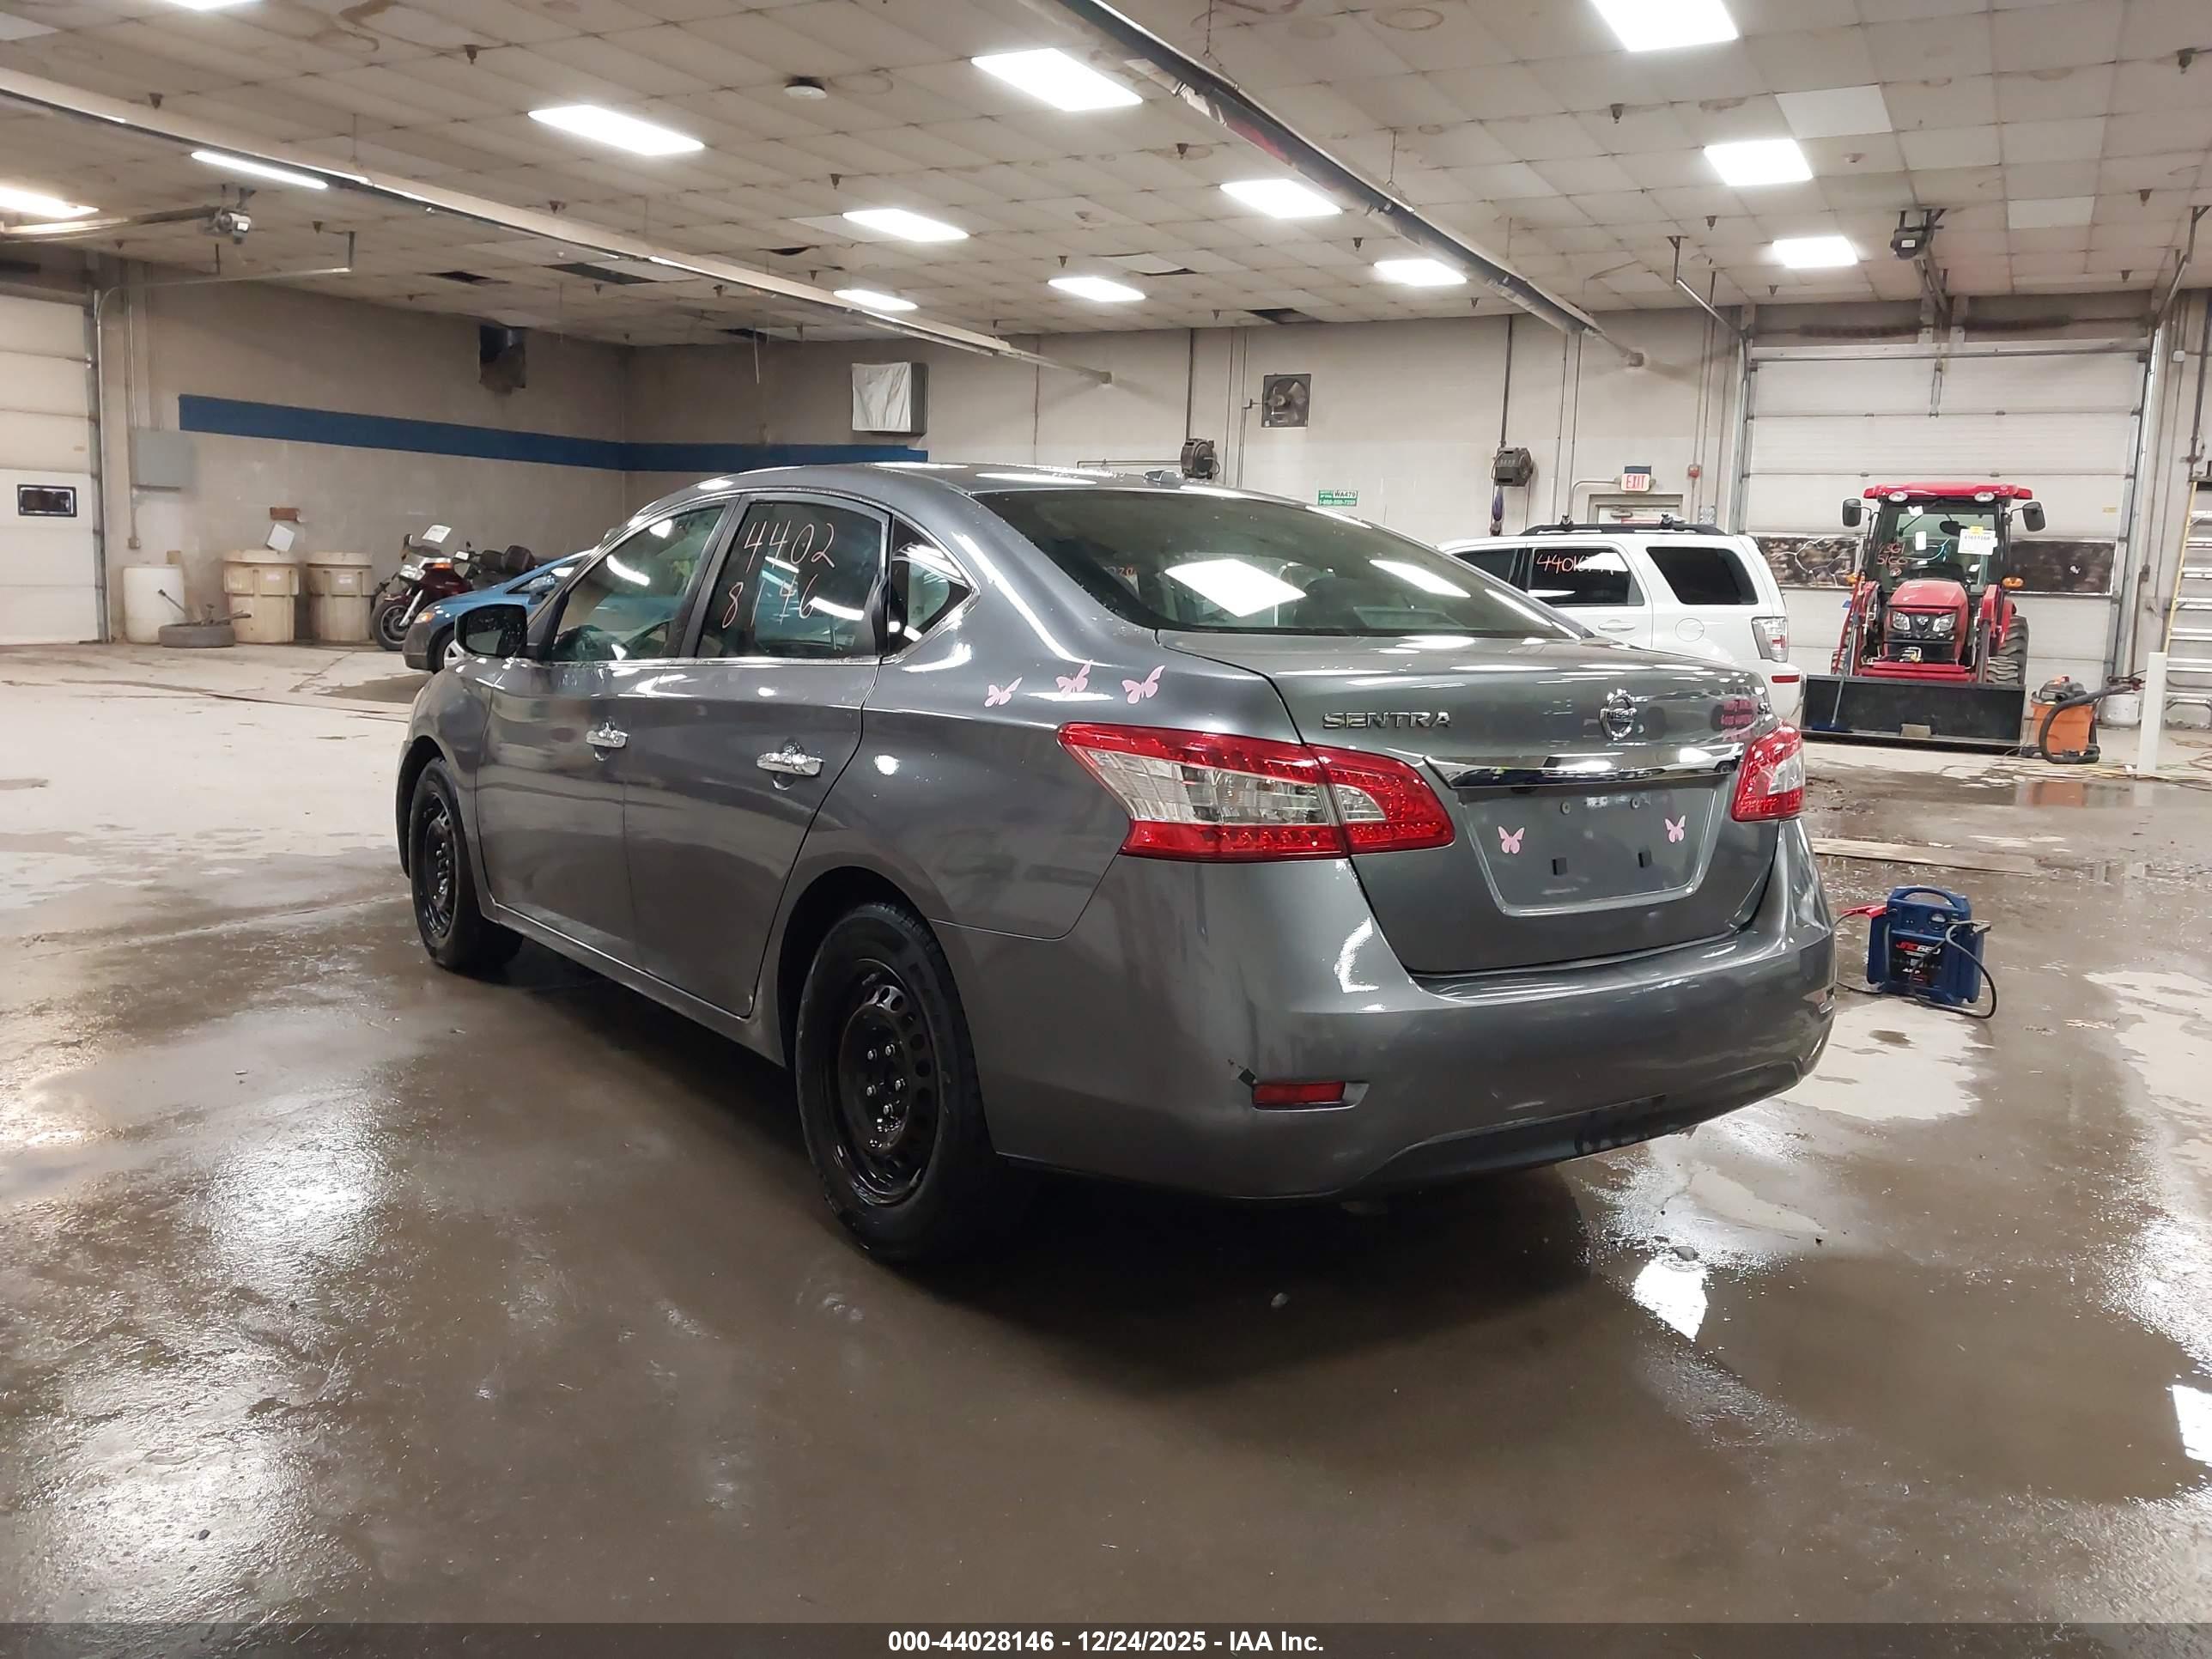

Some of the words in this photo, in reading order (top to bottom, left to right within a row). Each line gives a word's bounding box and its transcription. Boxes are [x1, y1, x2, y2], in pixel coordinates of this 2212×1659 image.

[1626, 474, 1646, 489] EXIT
[744, 520, 835, 574] 4402
[1322, 711, 1451, 729] SENTRA
